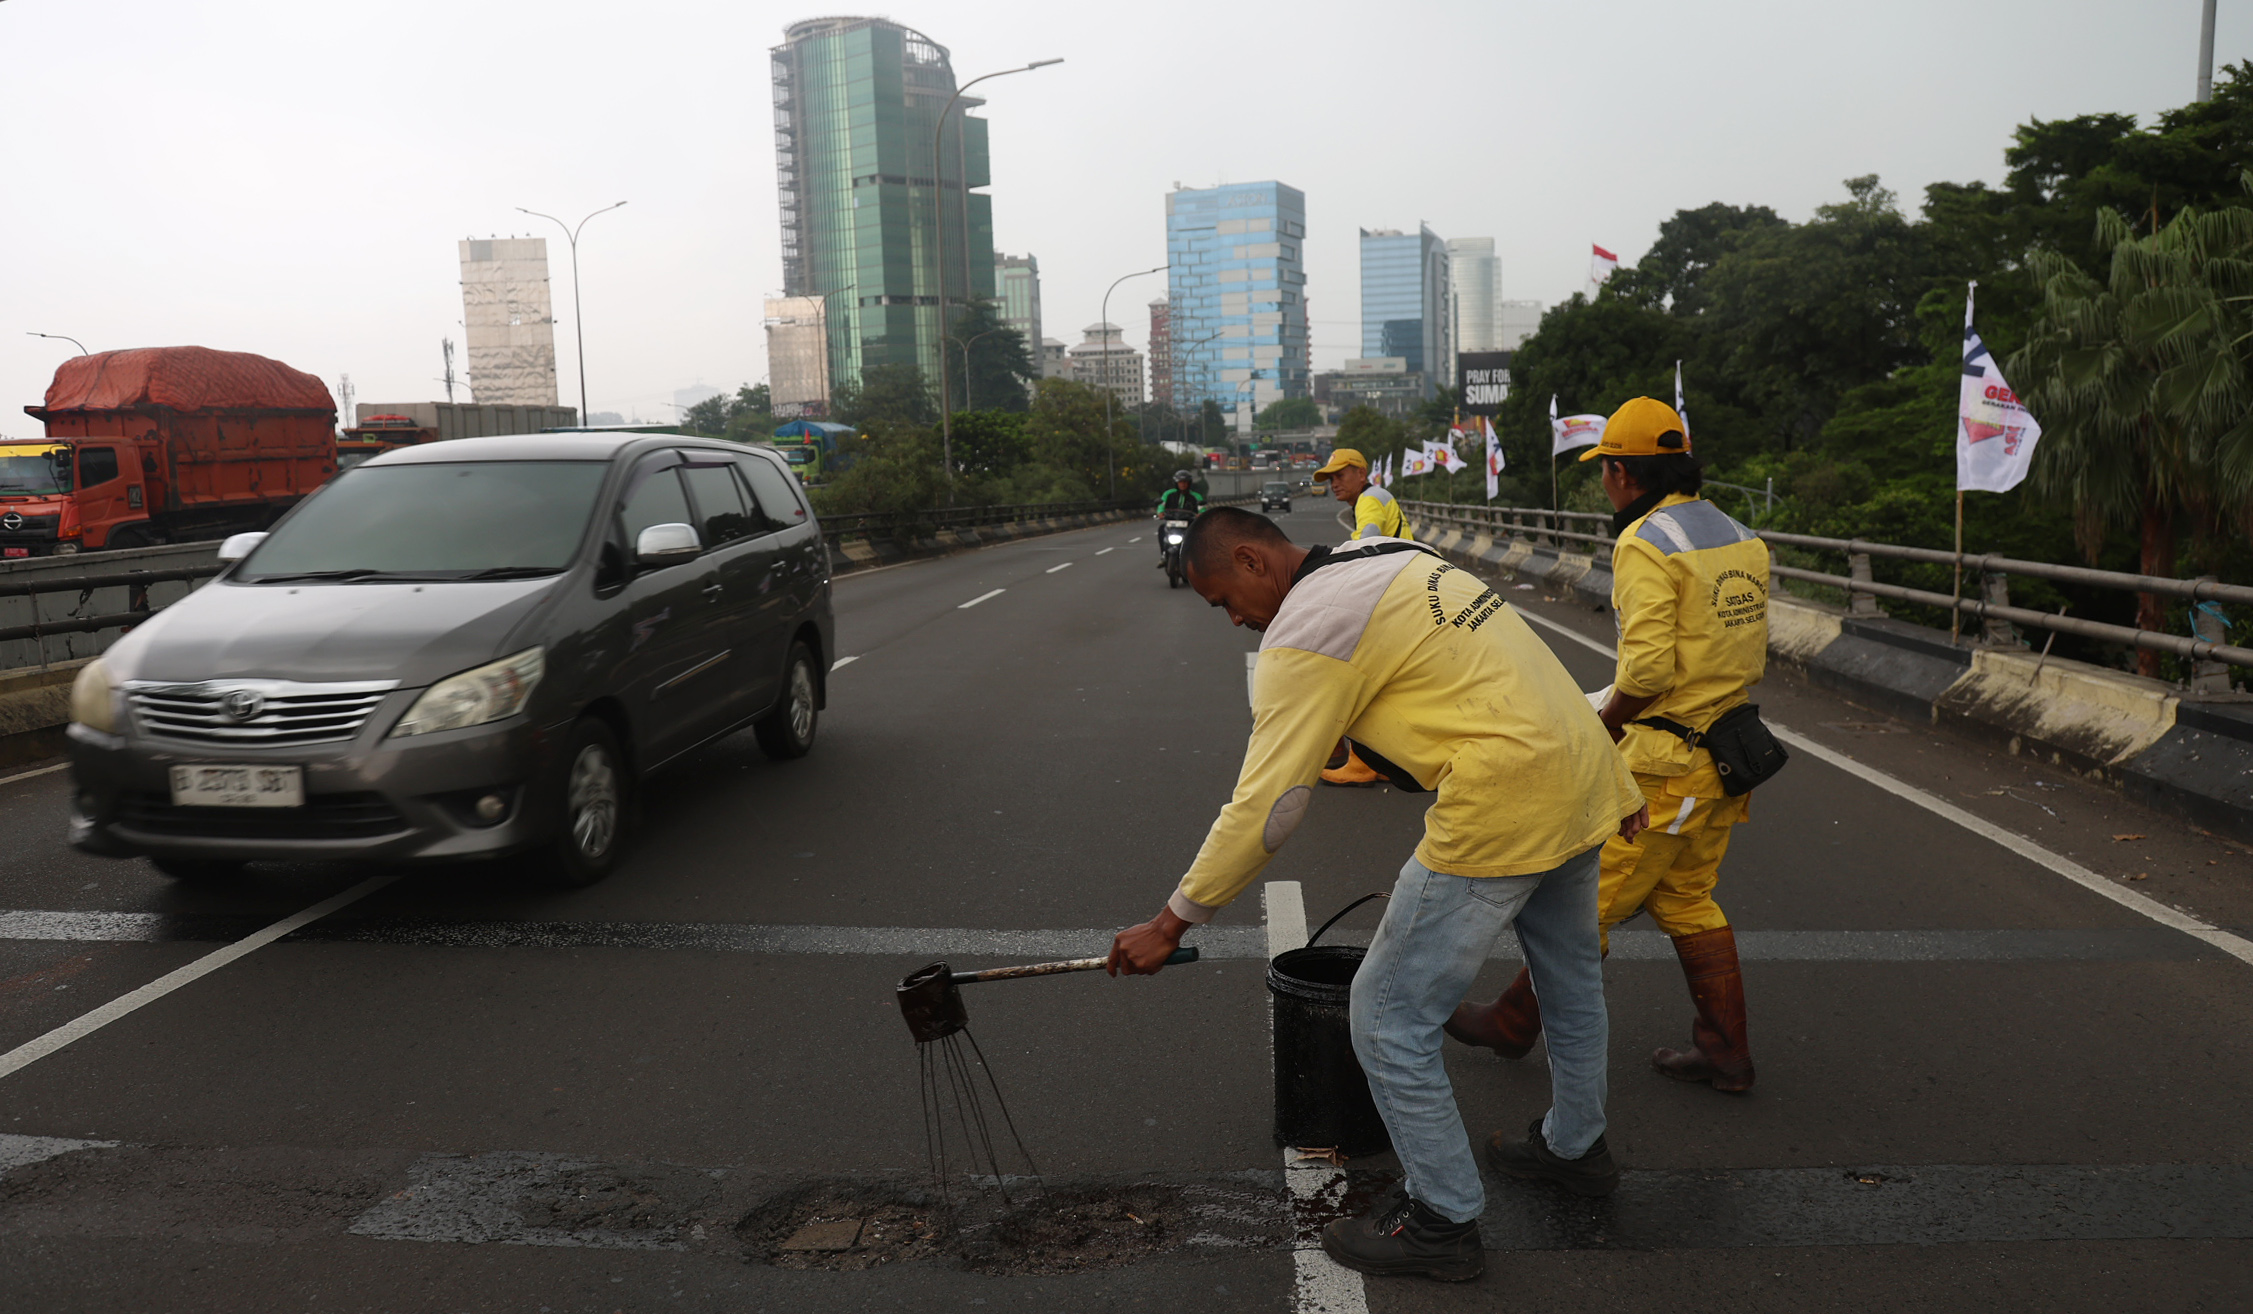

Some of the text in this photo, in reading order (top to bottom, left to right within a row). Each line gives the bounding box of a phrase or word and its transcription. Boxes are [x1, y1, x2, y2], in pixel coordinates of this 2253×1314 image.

[1466, 368, 1511, 384] PRAY FOR
[1466, 384, 1513, 405] SUMA
[1428, 572, 1441, 592] DINAS
[1711, 584, 1720, 607] SUKU
[1728, 569, 1746, 579] BINA
[1725, 592, 1754, 607] SATGAS
[1428, 595, 1446, 625] SUKU
[1451, 608, 1474, 628] KOTA
[1467, 606, 1495, 632] JAKARTA
[1717, 610, 1733, 618] KOTA
[1724, 618, 1746, 628] JAKARTA
